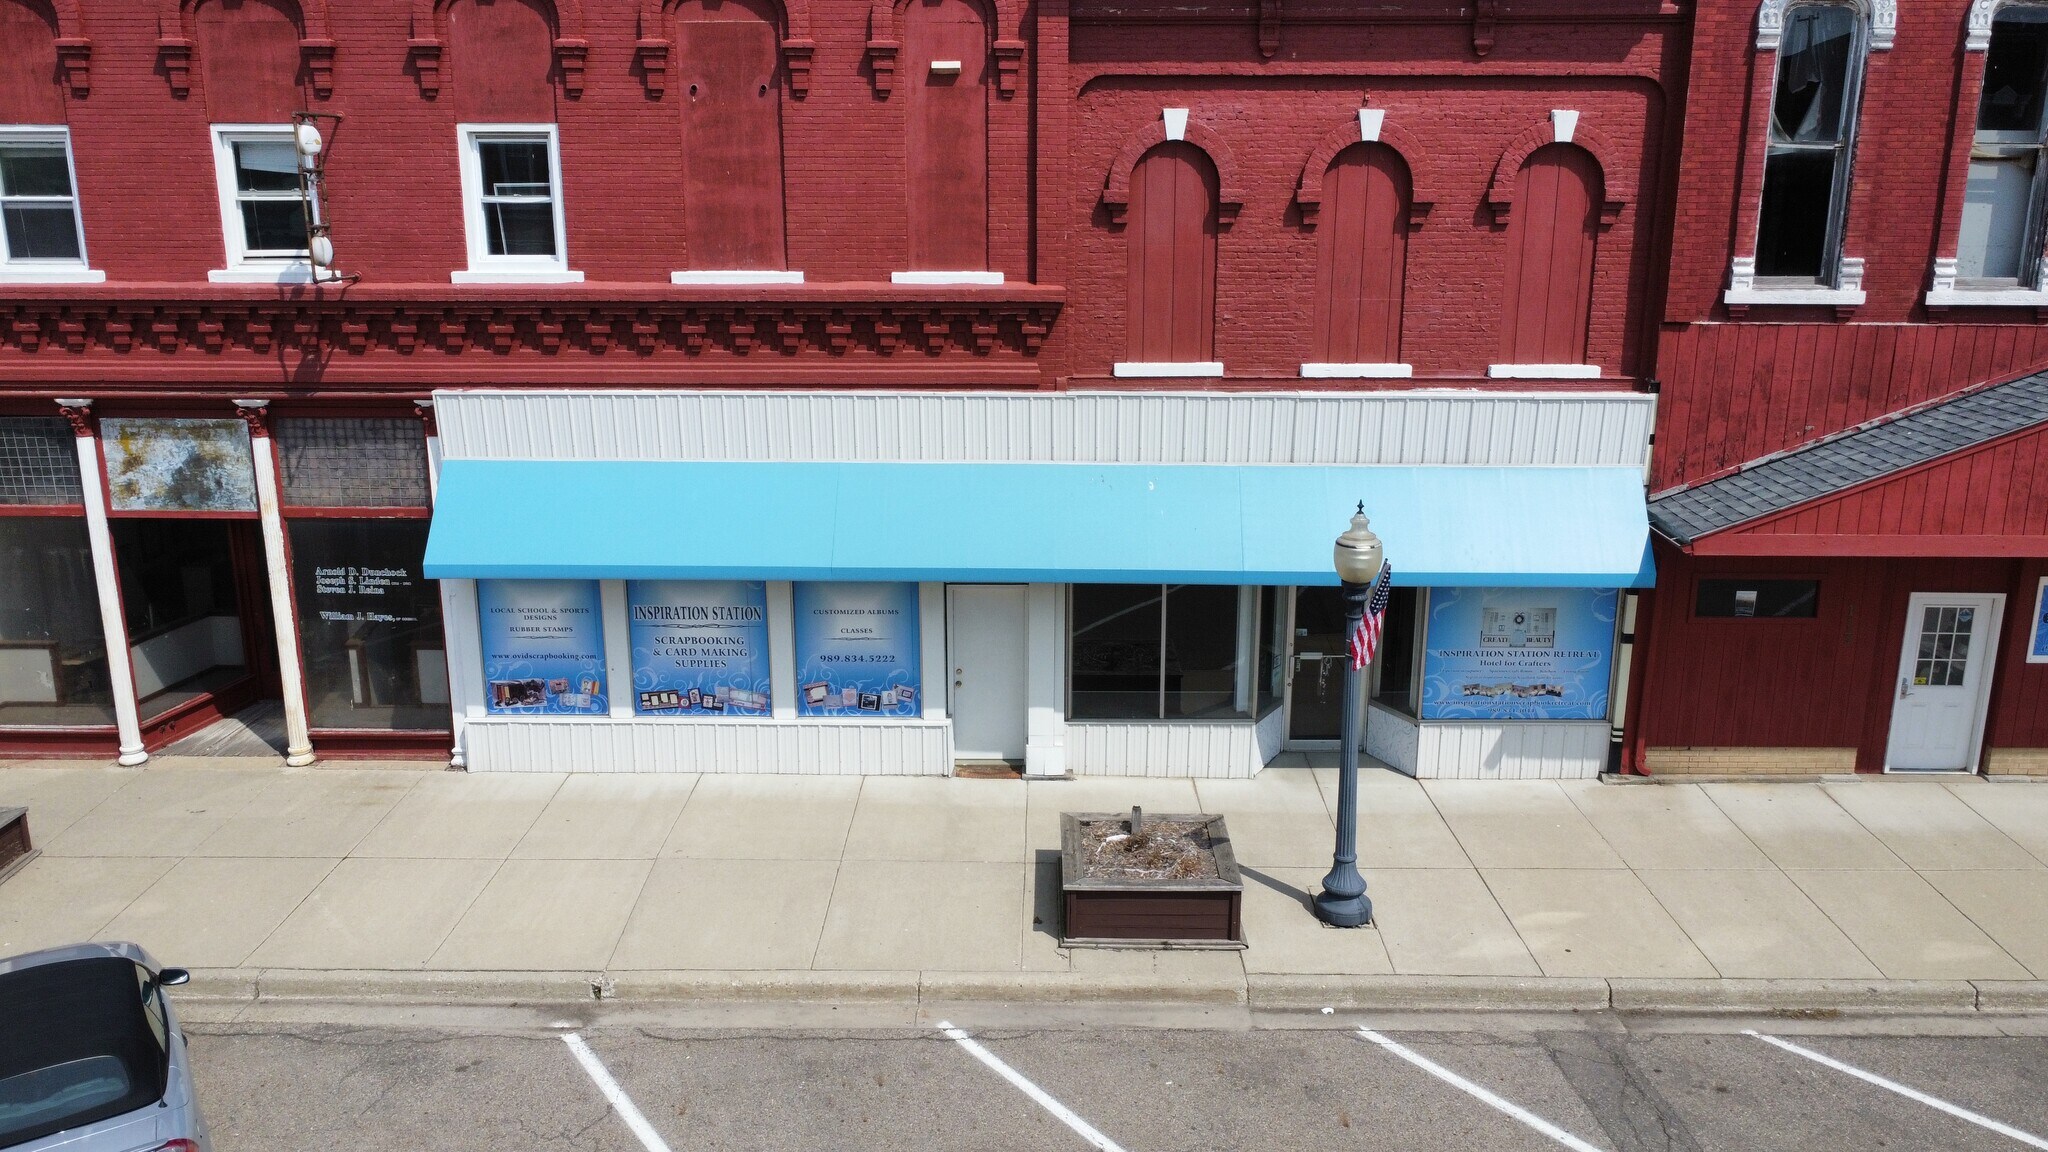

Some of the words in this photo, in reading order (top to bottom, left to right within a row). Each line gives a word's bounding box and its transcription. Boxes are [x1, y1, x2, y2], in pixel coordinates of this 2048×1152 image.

[315, 566, 345, 576] Arnold
[348, 567, 359, 576] D.
[316, 576, 346, 586] Joseph
[316, 584, 347, 594] Steven
[348, 585, 356, 594] J.
[319, 611, 355, 621] William
[356, 612, 365, 621] J.
[366, 612, 396, 622] Hayes,
[634, 606, 709, 620] INSPIRATION
[712, 606, 763, 621] STATION
[655, 636, 745, 645] SCRAPBOOKING
[491, 652, 597, 661] www.ovidscrapbooking.com
[653, 648, 661, 657] &
[665, 648, 697, 657] CARD
[701, 648, 748, 657] MAKING
[1439, 650, 1504, 658] INSPIRATION
[1507, 650, 1551, 658] STATION
[1553, 650, 1598, 658] RETREAT
[820, 654, 896, 663] 989.834.5222
[675, 660, 727, 668] SUPPLIES
